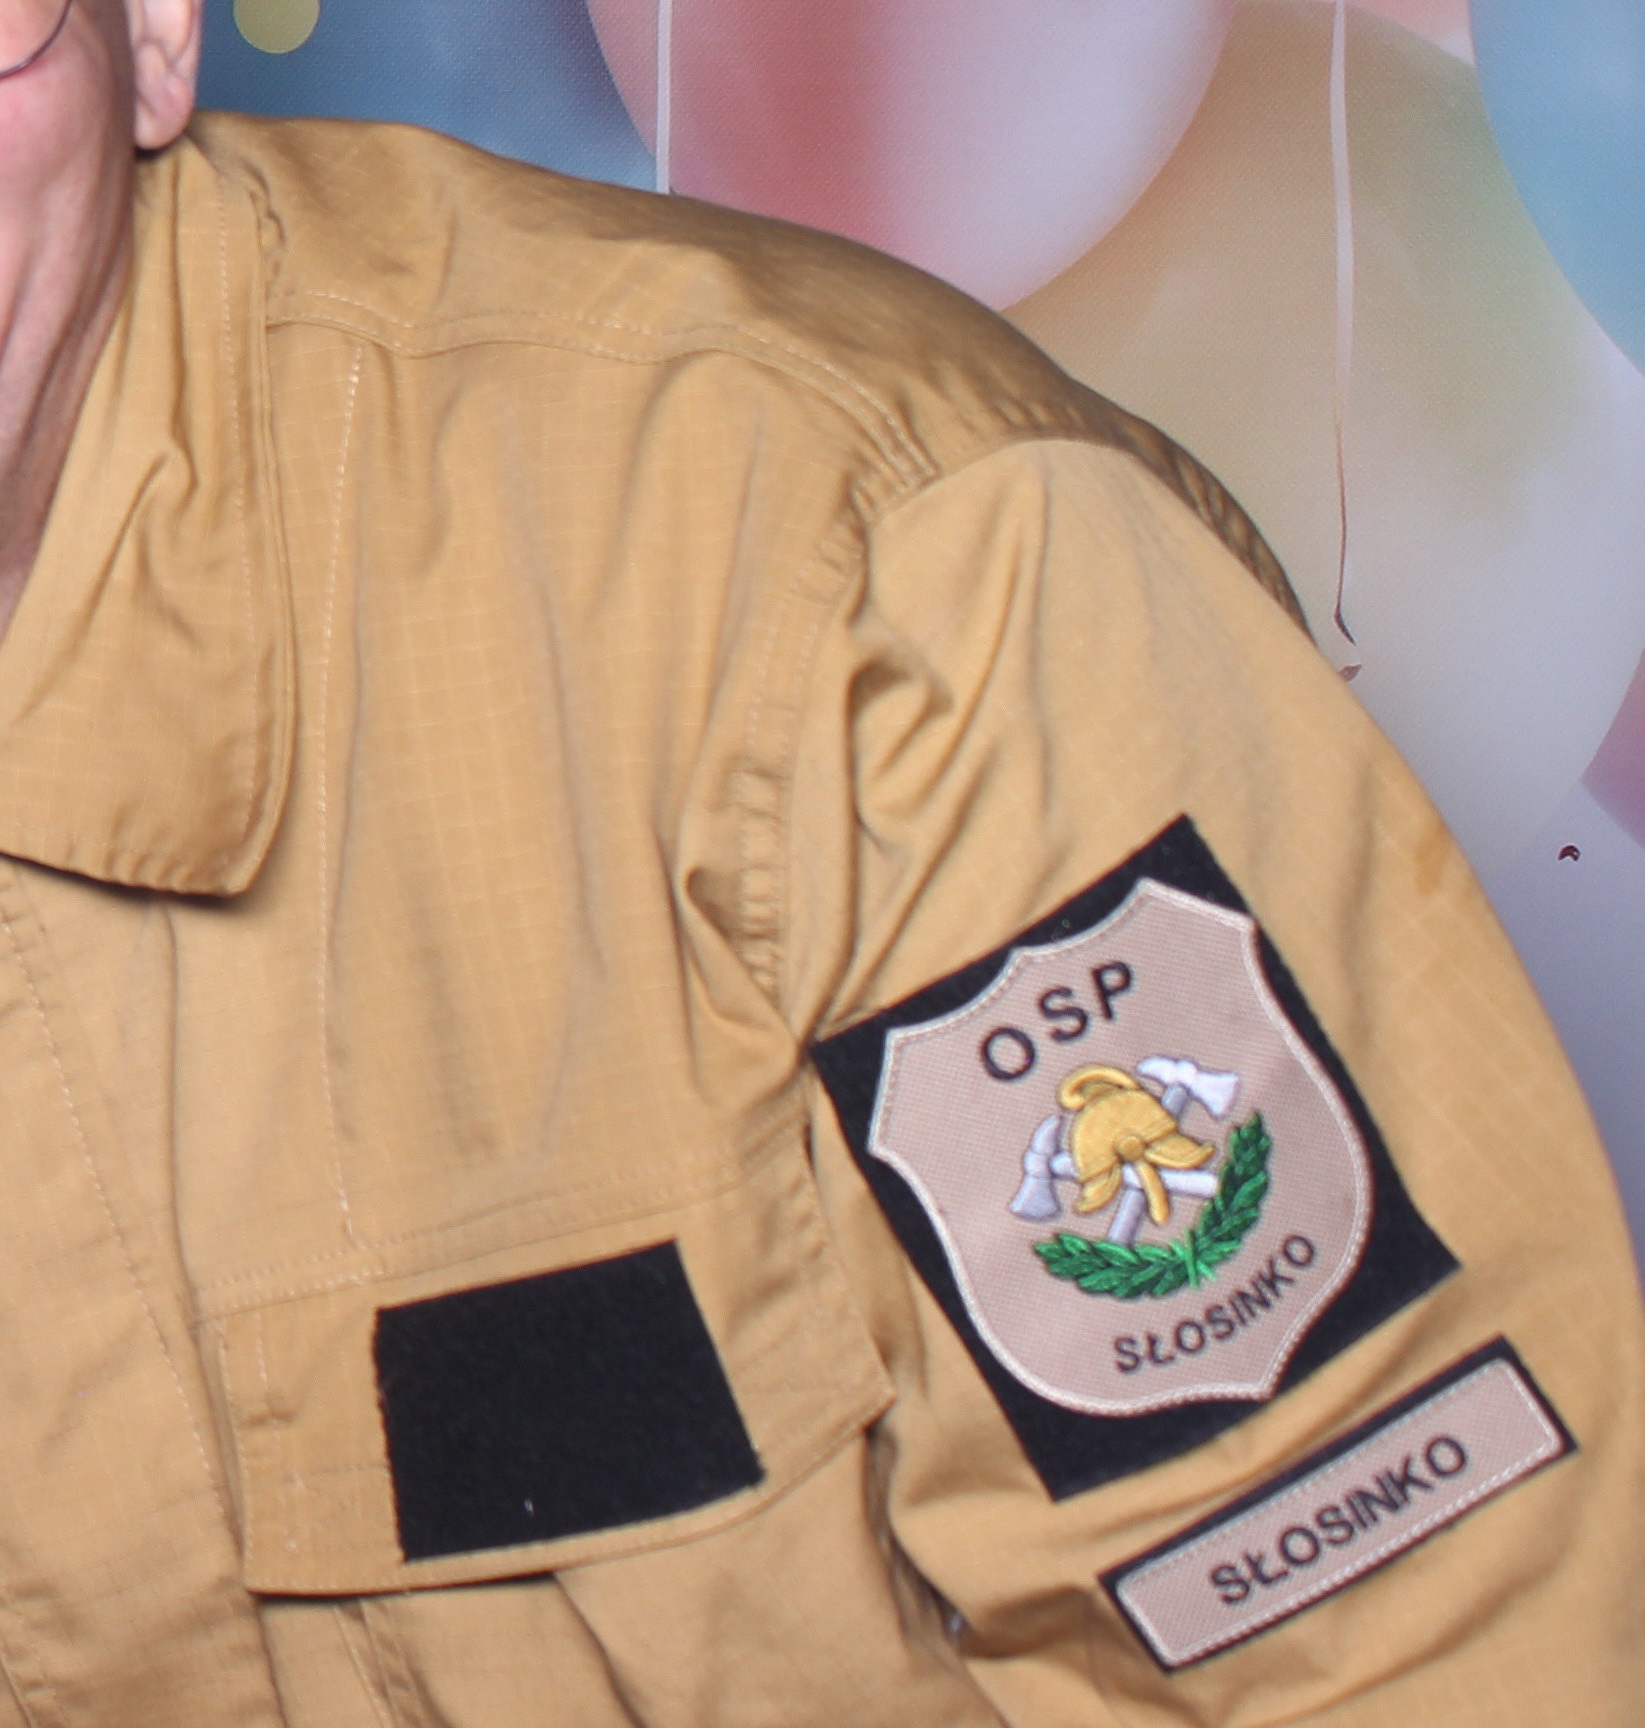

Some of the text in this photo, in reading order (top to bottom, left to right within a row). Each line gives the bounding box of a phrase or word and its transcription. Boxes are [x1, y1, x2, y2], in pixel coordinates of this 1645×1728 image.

[978, 960, 1135, 1082] OSP
[1112, 1232, 1317, 1375] SŁOSINKO
[1209, 1434, 1468, 1605] SŁOSINKO
